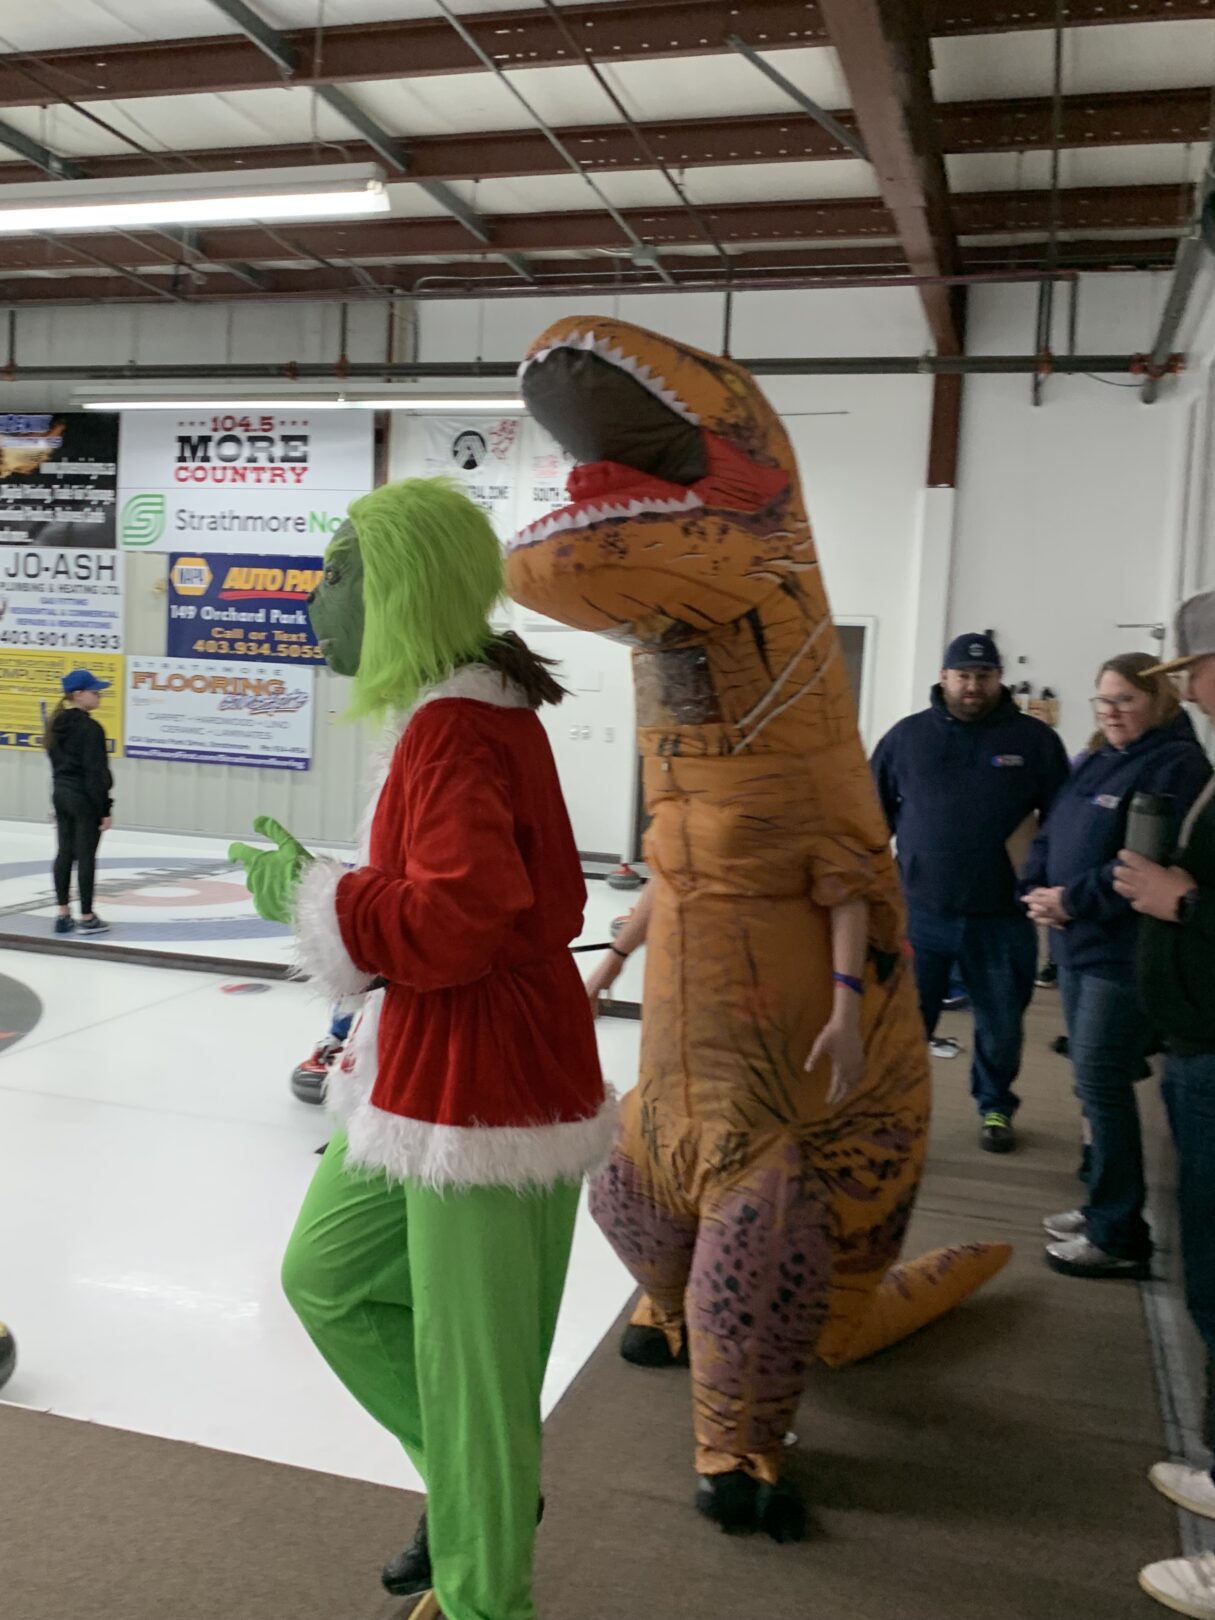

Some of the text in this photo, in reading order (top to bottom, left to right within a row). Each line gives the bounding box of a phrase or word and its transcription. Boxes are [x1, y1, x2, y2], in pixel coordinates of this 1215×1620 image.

[211, 415, 274, 432] 104.5
[176, 434, 309, 463] MORE
[174, 466, 309, 483] COUNTRY
[175, 509, 342, 534] StrathmoreNo
[4, 552, 117, 581] JO-ASH
[222, 567, 284, 591] AUTO
[170, 605, 307, 624] 149 Orchard Park
[0, 630, 120, 649] 403.901.6393
[211, 627, 307, 642] Call or Text
[131, 671, 288, 696] FLOORING
